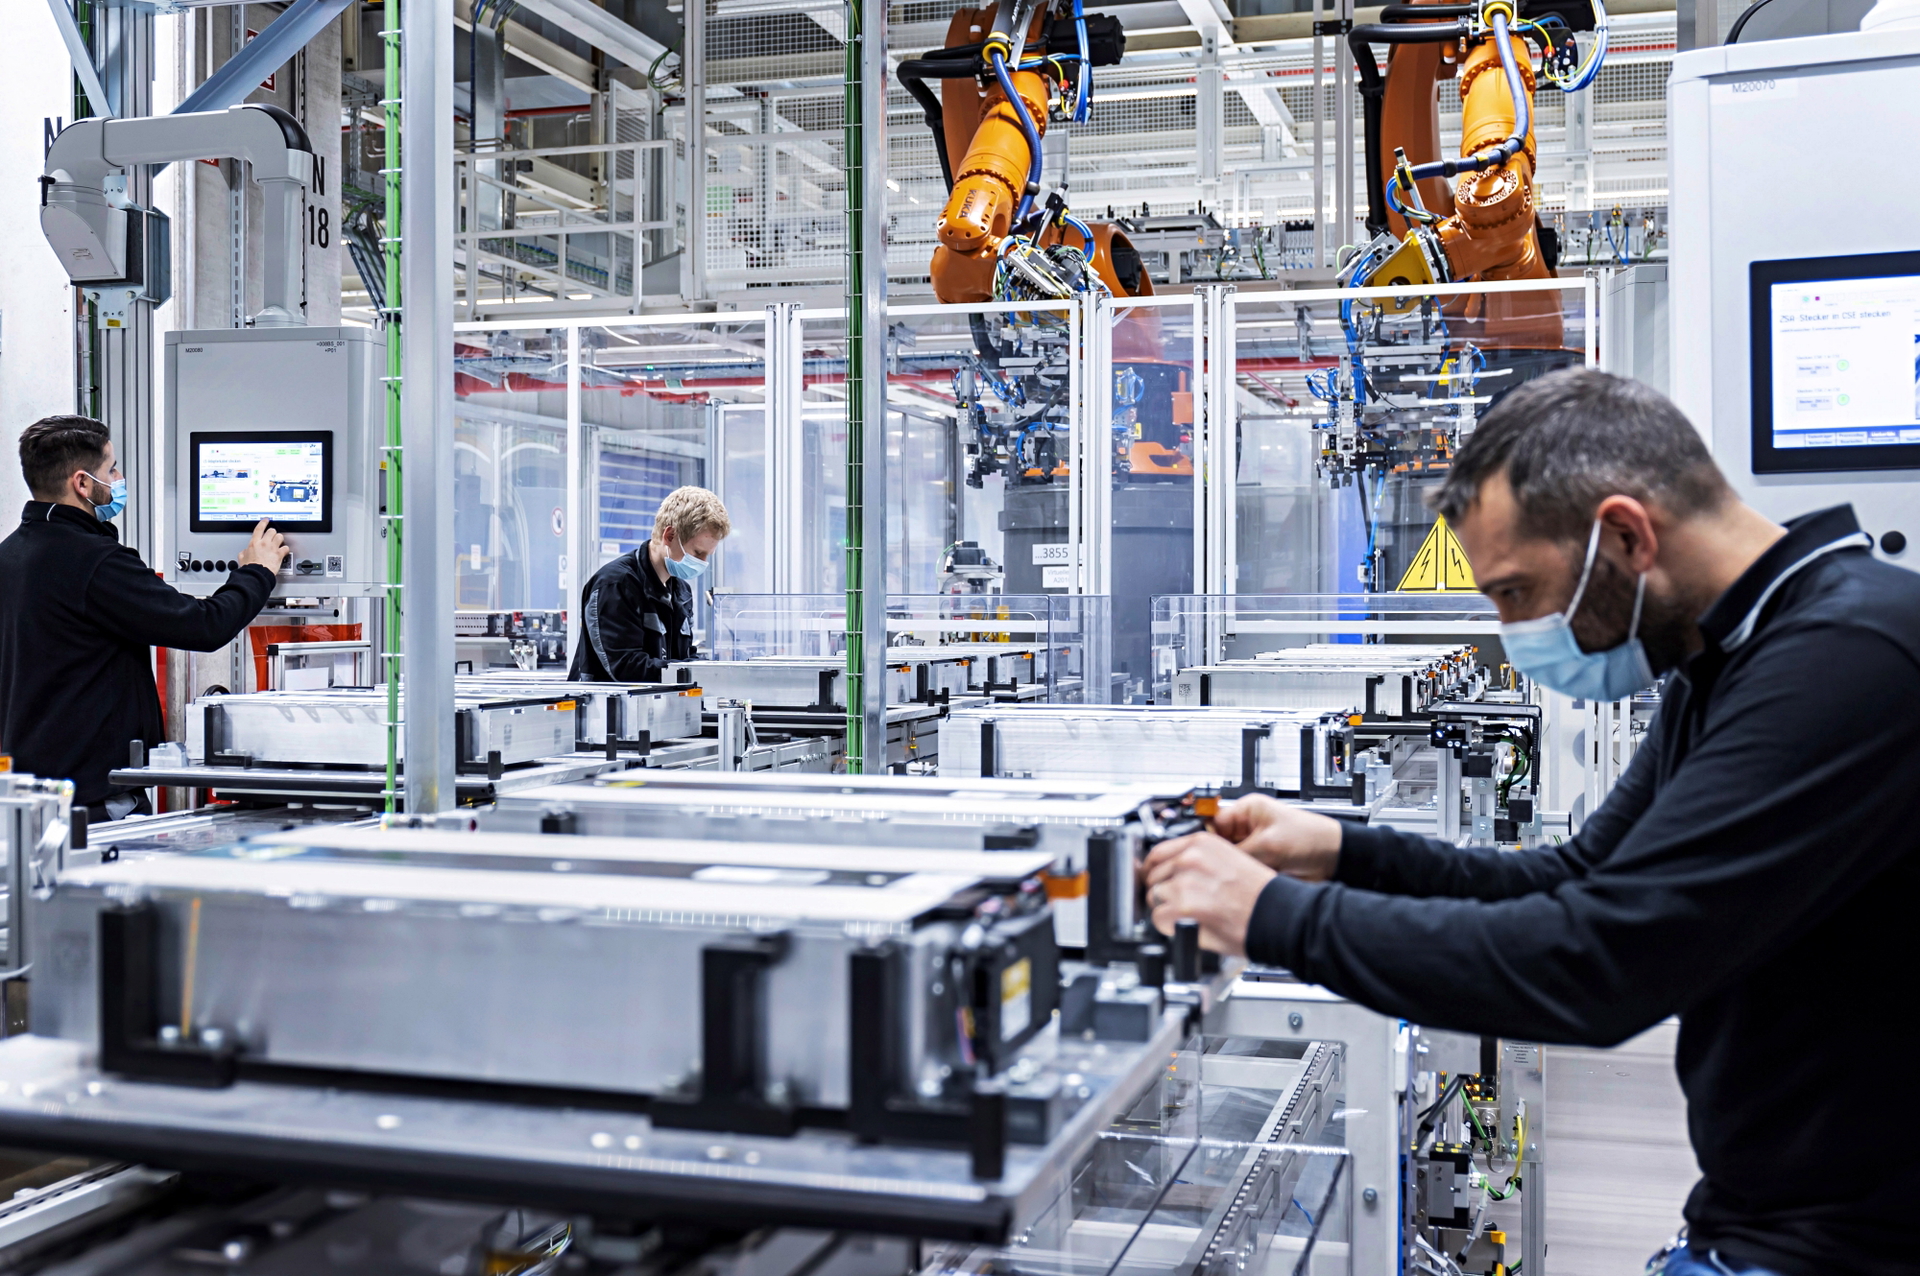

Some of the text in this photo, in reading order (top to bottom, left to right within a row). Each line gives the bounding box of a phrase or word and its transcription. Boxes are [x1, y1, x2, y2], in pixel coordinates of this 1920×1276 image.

[1732, 79, 1776, 93] M20070
[313, 153, 325, 196] N
[959, 190, 977, 218] KUKA
[308, 204, 329, 249] 18
